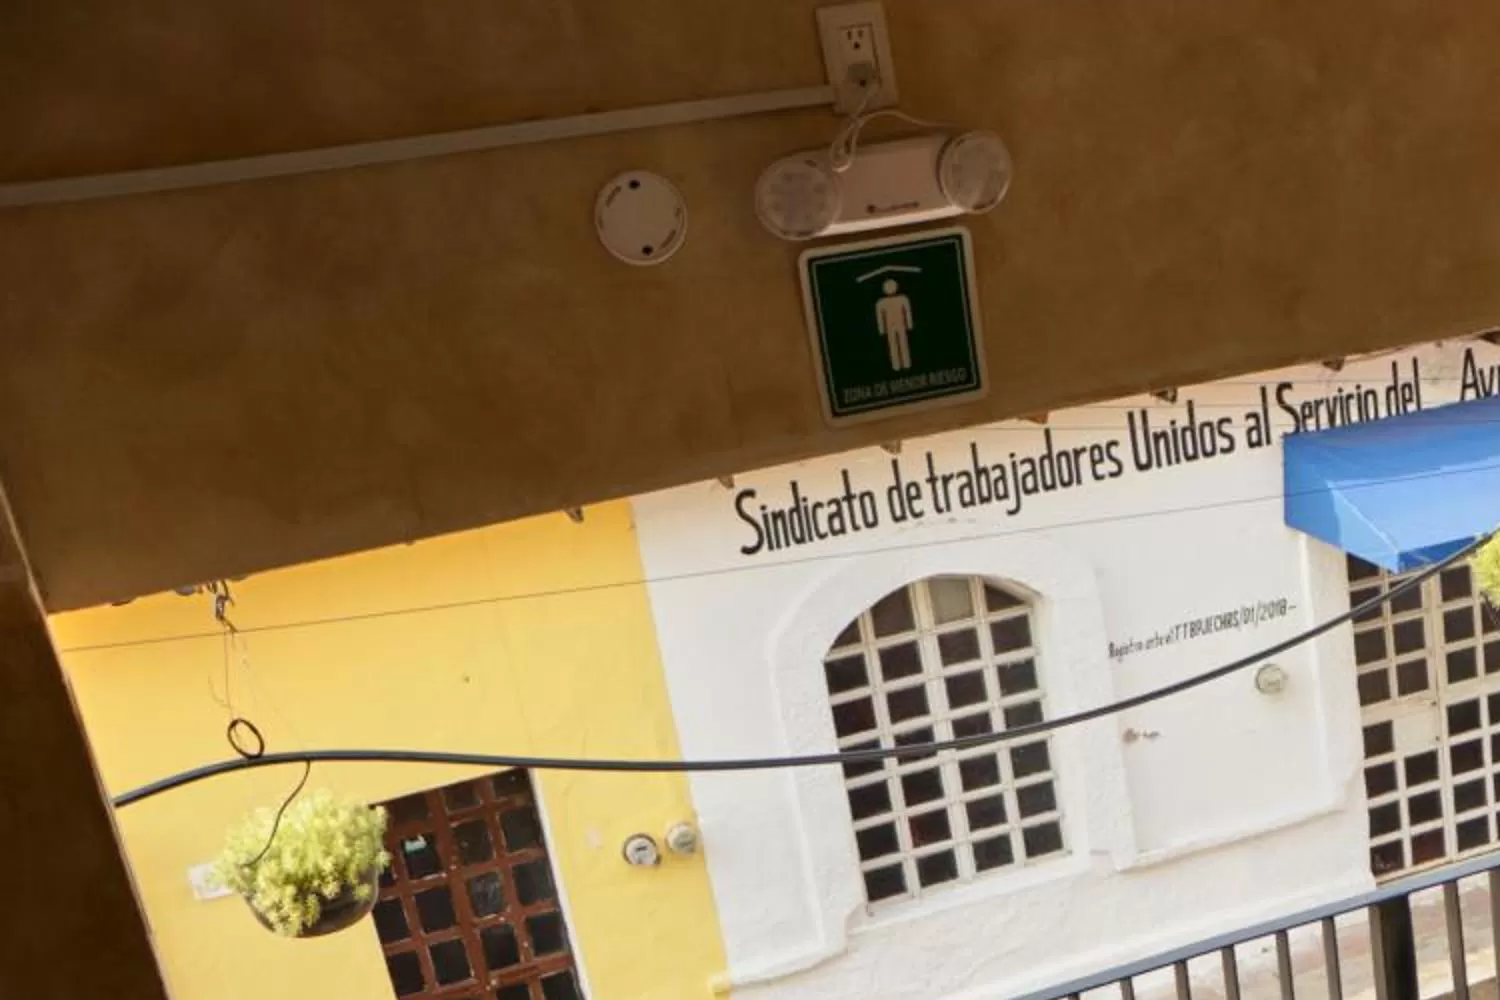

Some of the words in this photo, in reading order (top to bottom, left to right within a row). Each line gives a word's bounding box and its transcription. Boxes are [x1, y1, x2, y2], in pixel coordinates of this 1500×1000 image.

[873, 381, 889, 397] DE
[929, 367, 968, 386] RIESGO
[735, 468, 879, 555] Sindicato
[887, 458, 925, 523] de
[926, 428, 1124, 516] trabajadores
[1127, 399, 1236, 472] Unidos
[1245, 385, 1273, 450] al
[1275, 381, 1379, 434] Servicio
[1385, 356, 1422, 417] del
